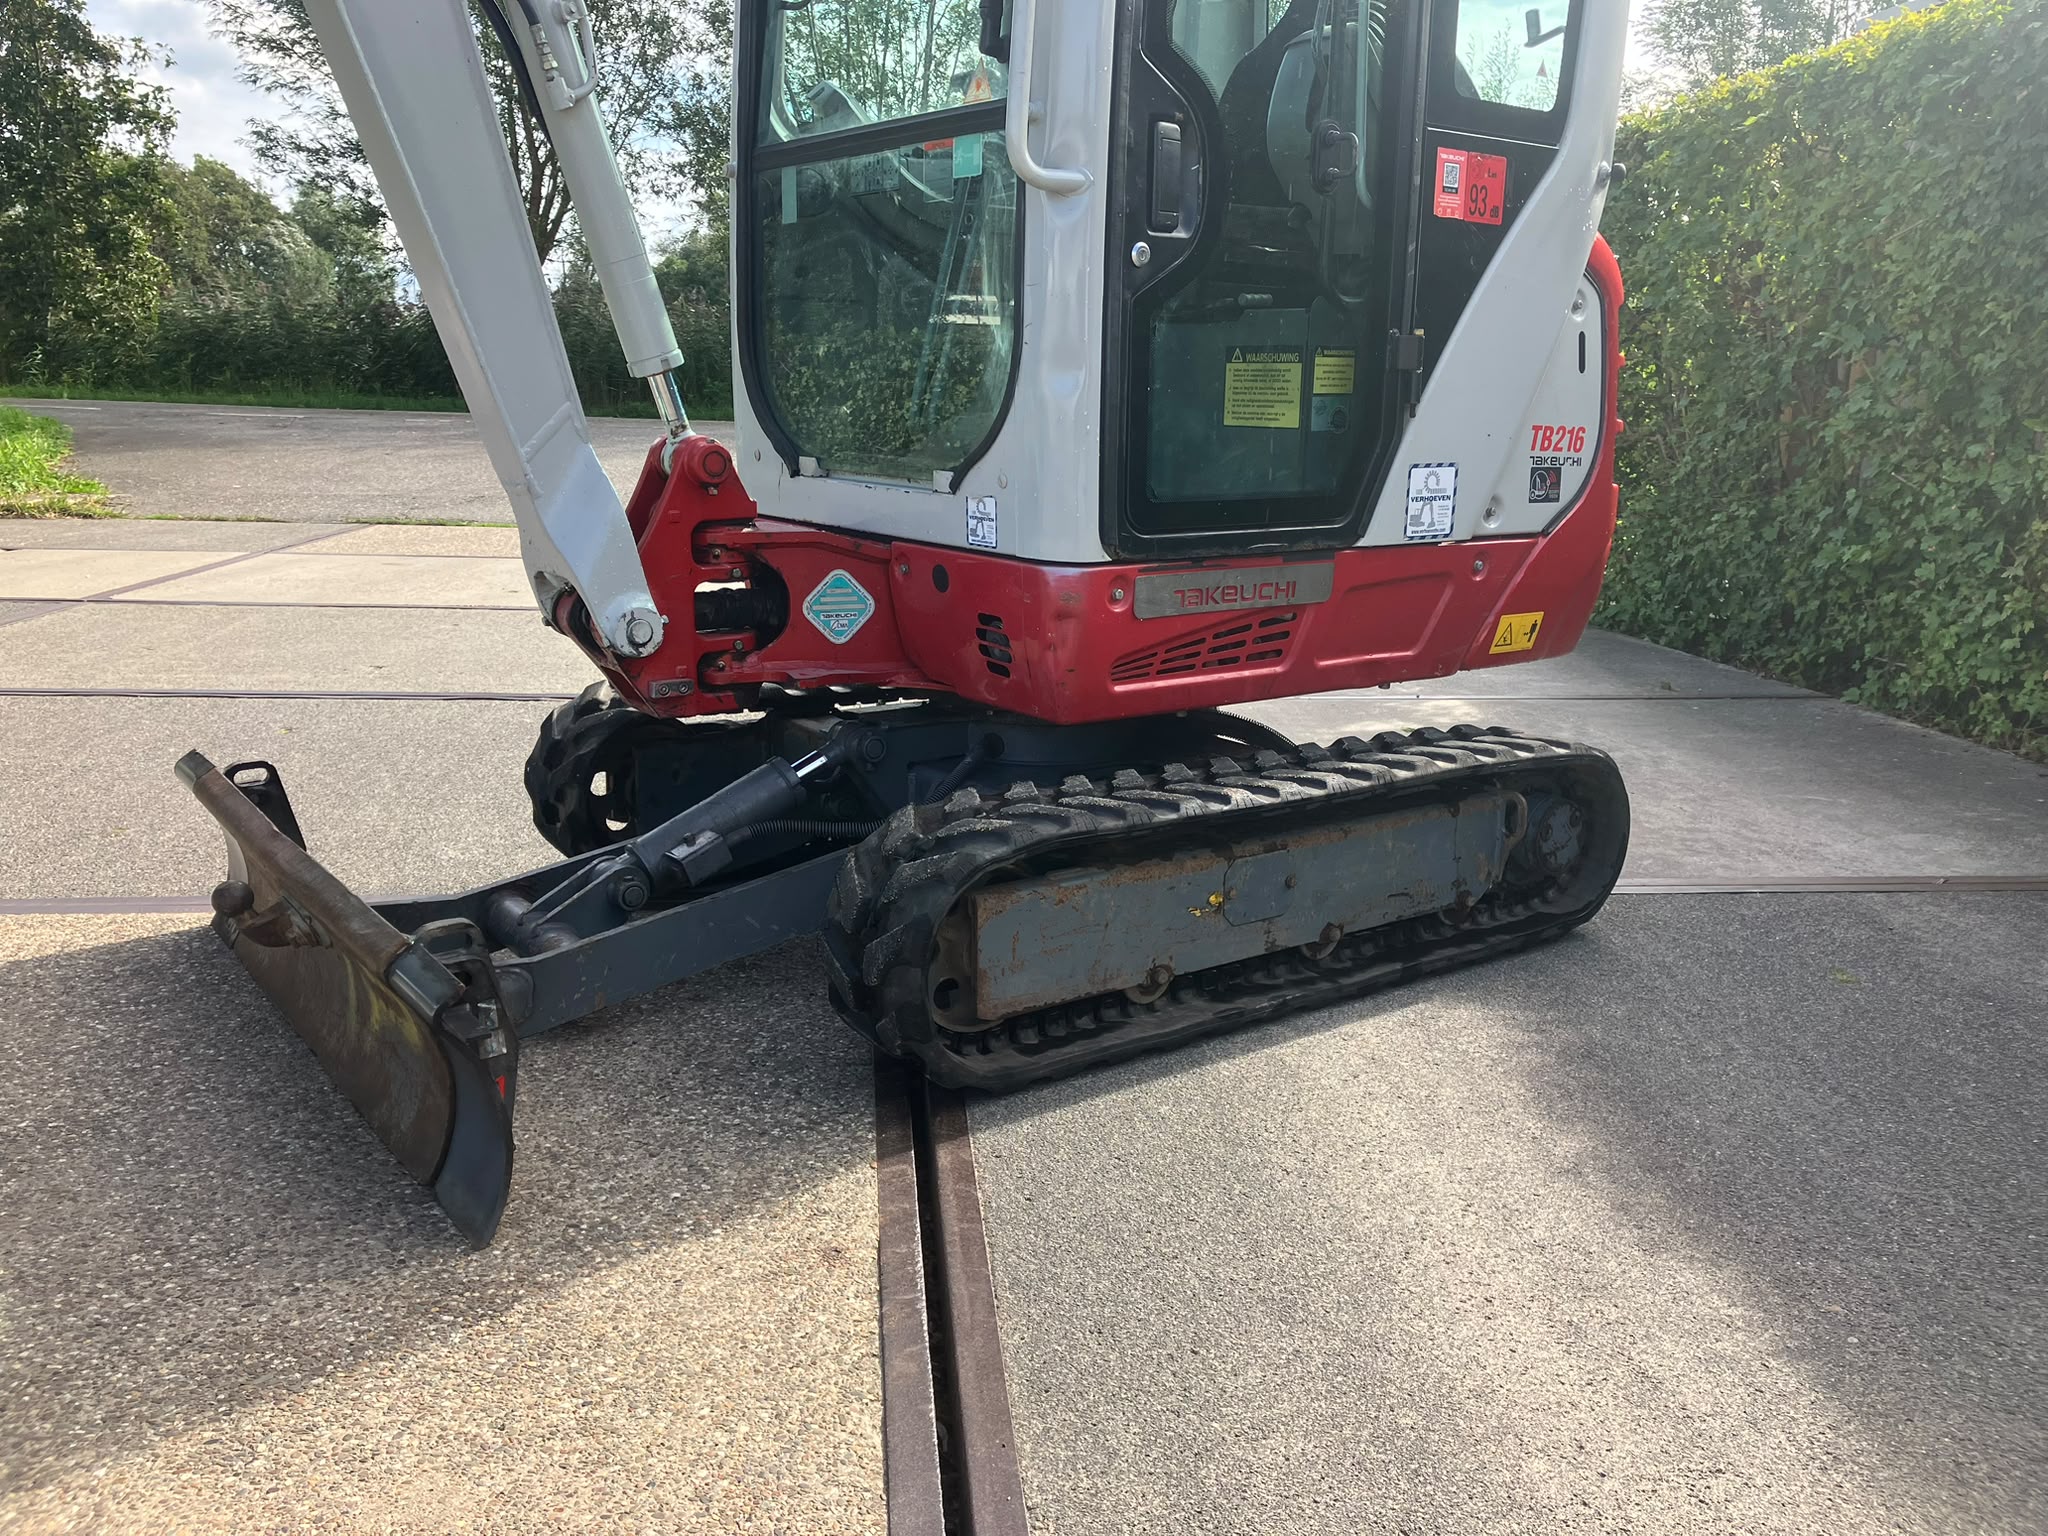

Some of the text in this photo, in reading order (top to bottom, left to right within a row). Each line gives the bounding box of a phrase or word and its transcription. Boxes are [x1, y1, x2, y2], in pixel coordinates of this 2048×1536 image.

[1469, 183, 1488, 217] 93
[1530, 424, 1587, 454] TB216
[1410, 494, 1452, 503] VERHOEVEN
[1173, 580, 1297, 608] TAKEUCHI
